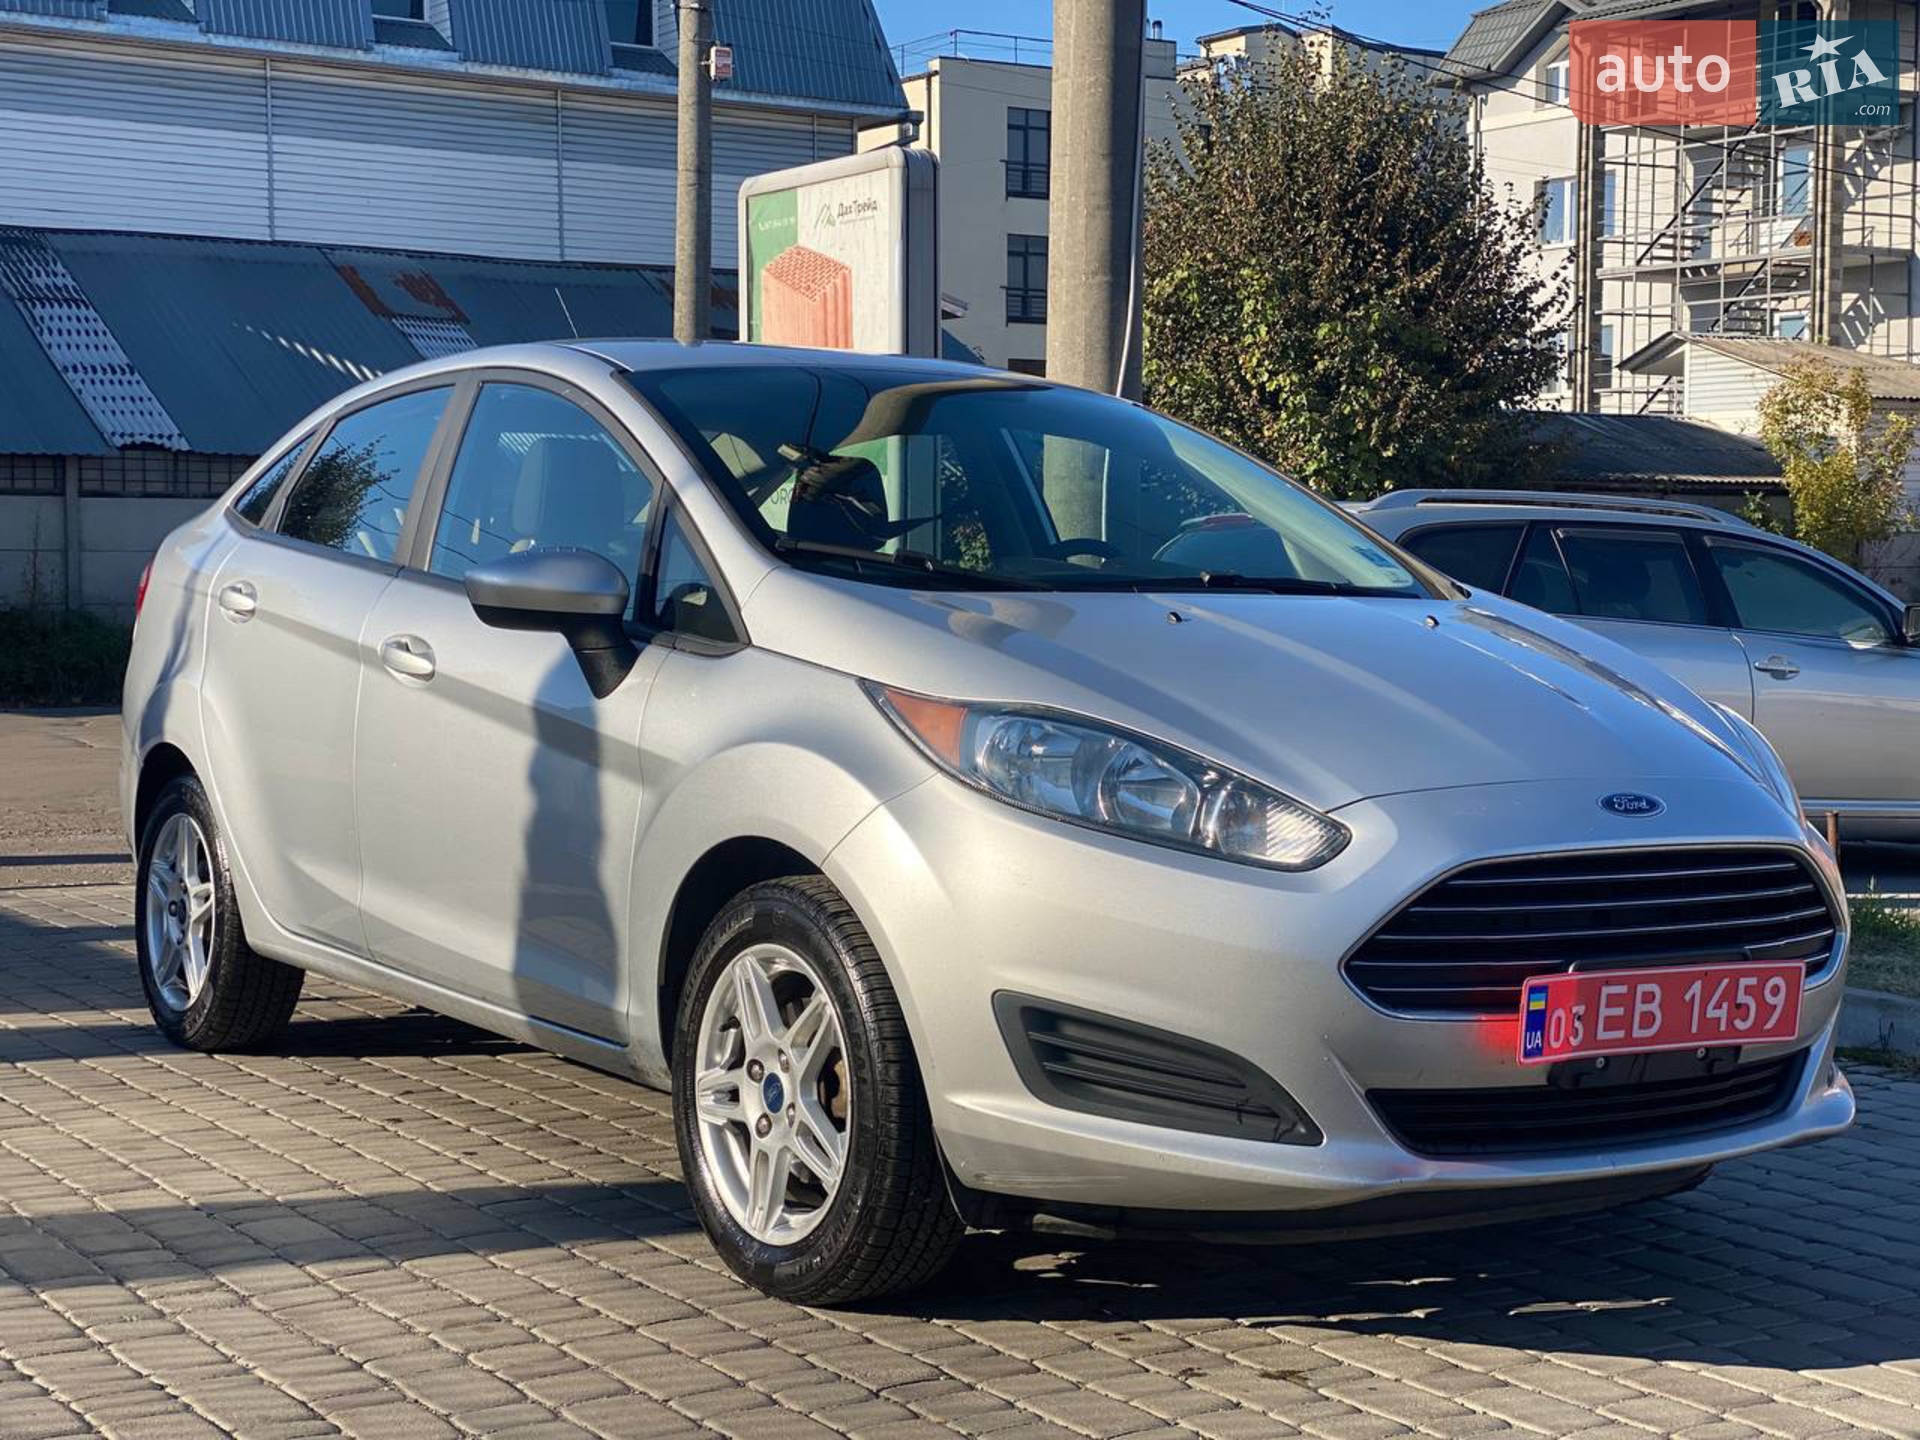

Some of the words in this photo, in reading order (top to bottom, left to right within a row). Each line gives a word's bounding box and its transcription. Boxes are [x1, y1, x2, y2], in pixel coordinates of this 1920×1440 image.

[1613, 796, 1650, 811] Ford
[1683, 975, 1786, 1034] 1459
[1526, 1031, 1543, 1049] UA
